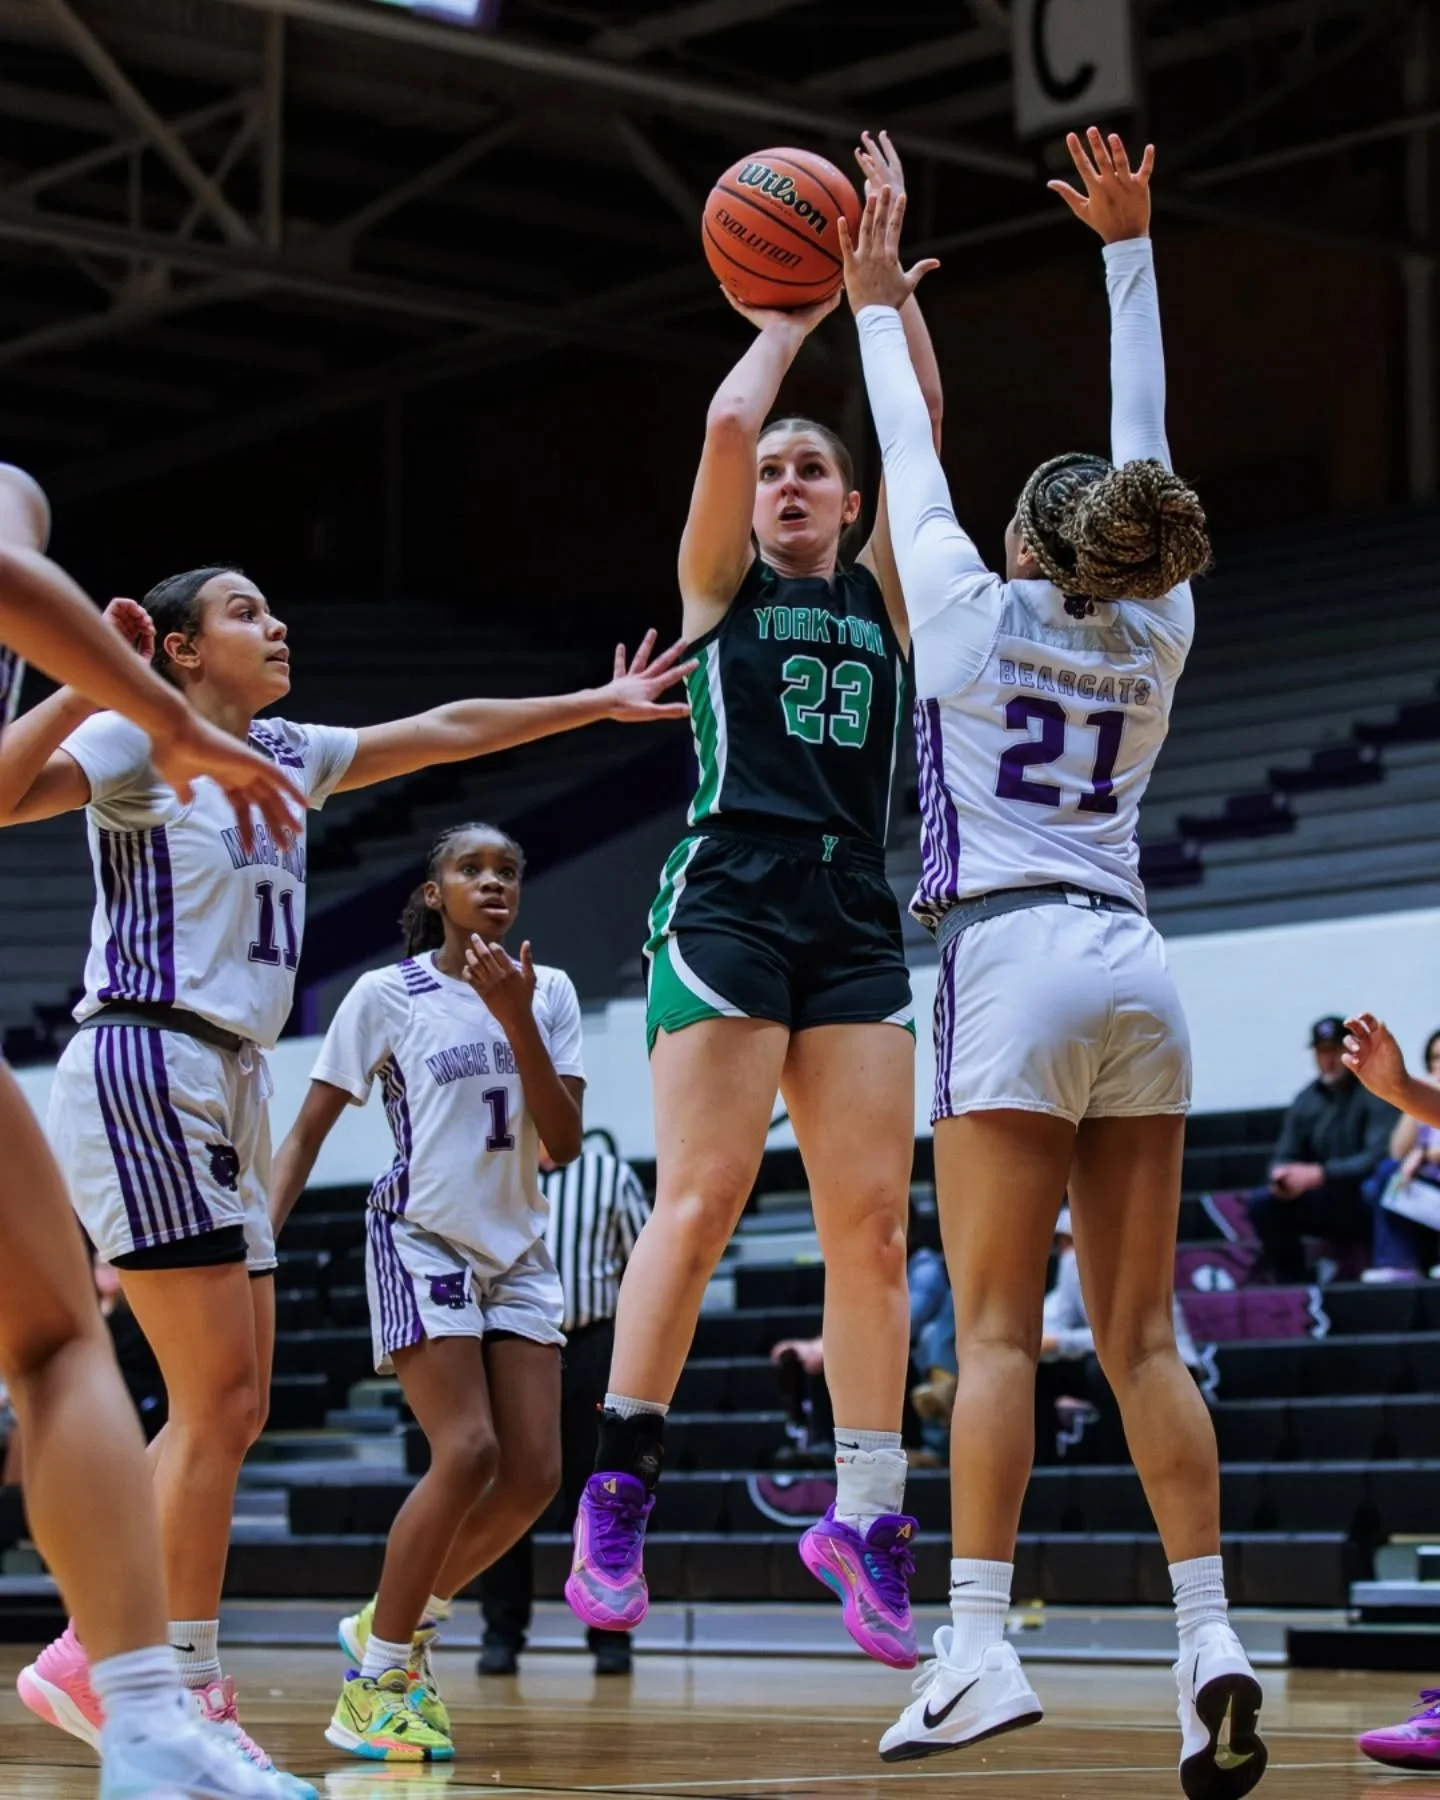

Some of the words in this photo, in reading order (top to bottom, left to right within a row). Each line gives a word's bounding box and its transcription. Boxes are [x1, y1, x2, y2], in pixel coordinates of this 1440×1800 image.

[1031, 0, 1097, 104] C
[737, 162, 829, 237] Wilson
[715, 208, 803, 267] EVOLUTION
[753, 606, 887, 658] YORKTOWN
[780, 655, 873, 749] 23
[999, 659, 1151, 706] BEARCATS
[994, 695, 1126, 815] 21
[822, 834, 840, 862] Y
[248, 880, 299, 972] 11
[425, 1042, 490, 1087] MUNCIE
[482, 1086, 515, 1152] 1
